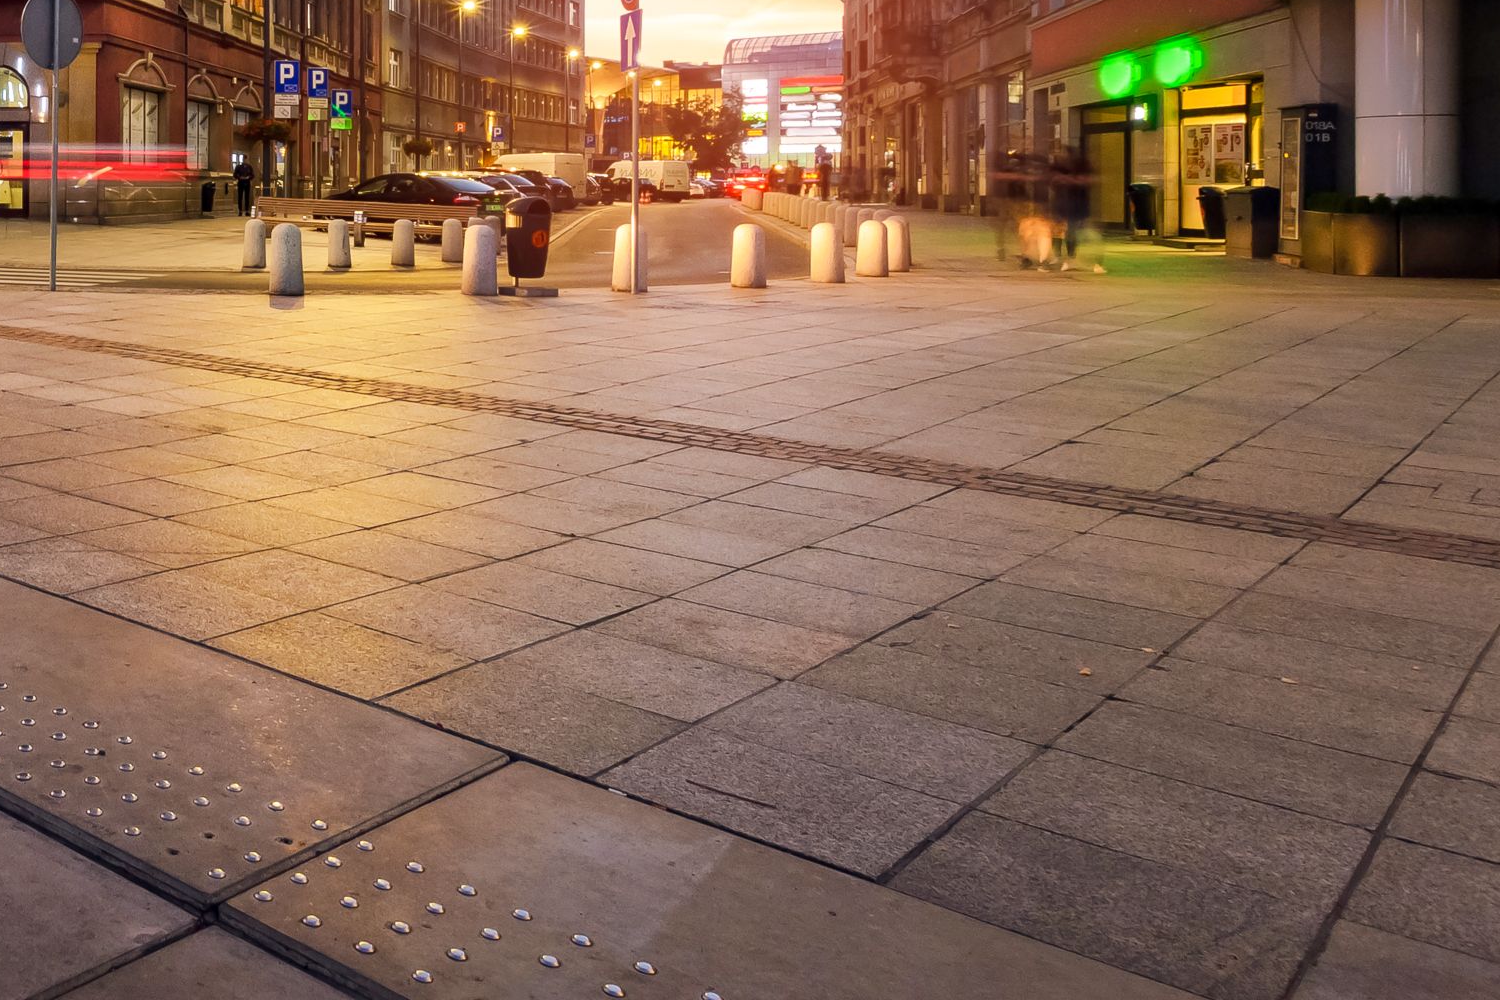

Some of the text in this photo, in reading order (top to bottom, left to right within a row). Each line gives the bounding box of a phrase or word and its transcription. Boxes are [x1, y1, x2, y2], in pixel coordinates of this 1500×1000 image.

[280, 63, 294, 84] P
[312, 70, 324, 89] P
[336, 92, 348, 110] P
[494, 127, 502, 137] P
